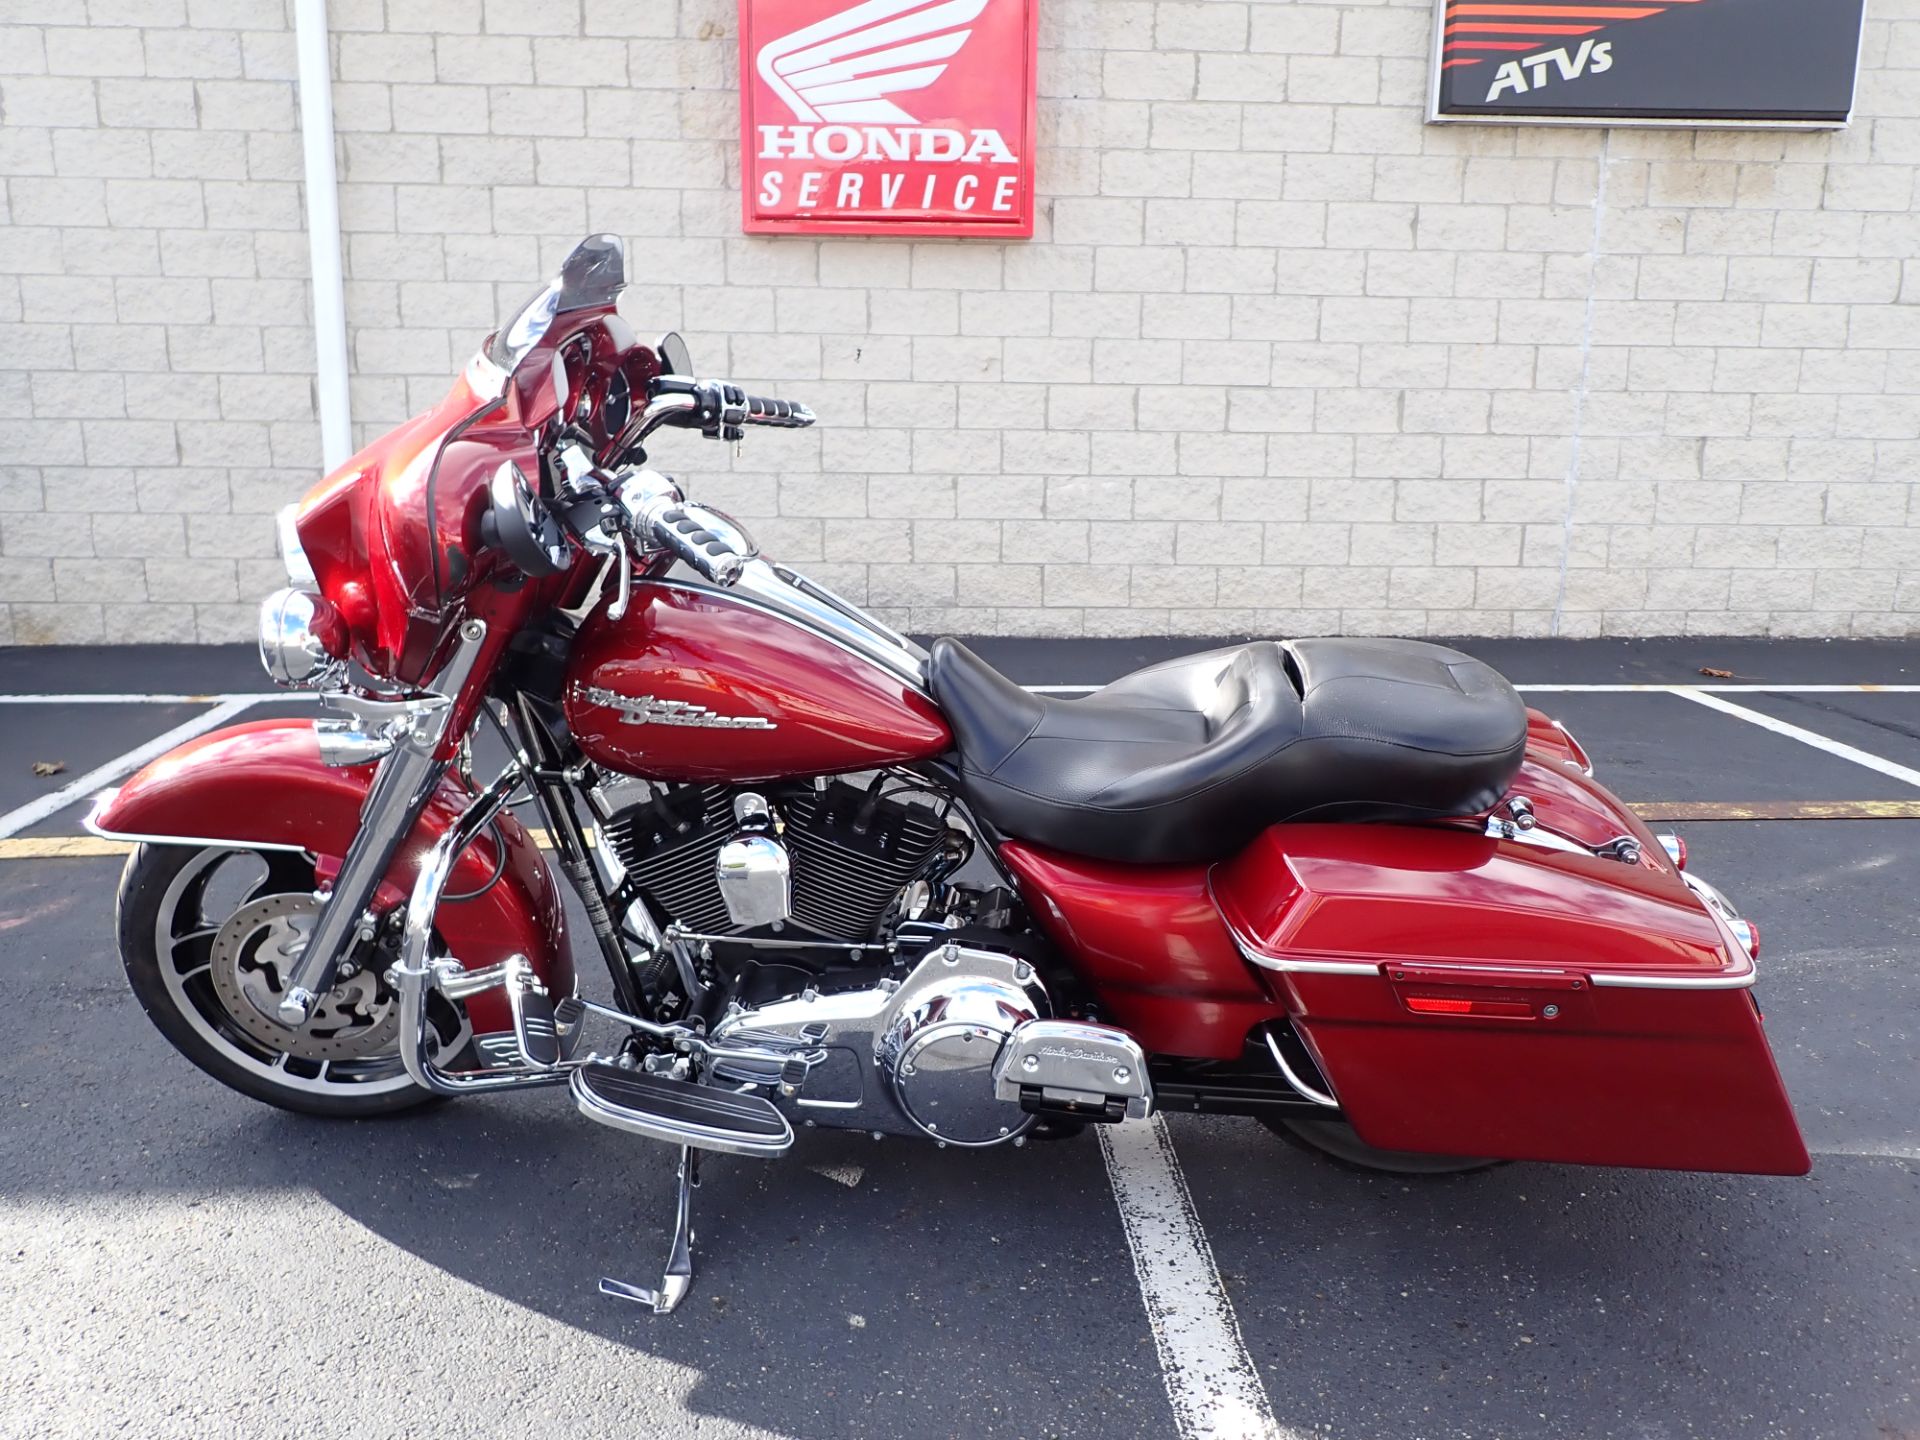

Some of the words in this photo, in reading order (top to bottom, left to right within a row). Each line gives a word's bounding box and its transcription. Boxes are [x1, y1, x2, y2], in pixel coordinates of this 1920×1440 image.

[1485, 38, 1613, 103] ATVs
[757, 124, 1019, 163] HONDA
[758, 170, 1018, 212] SERVICE
